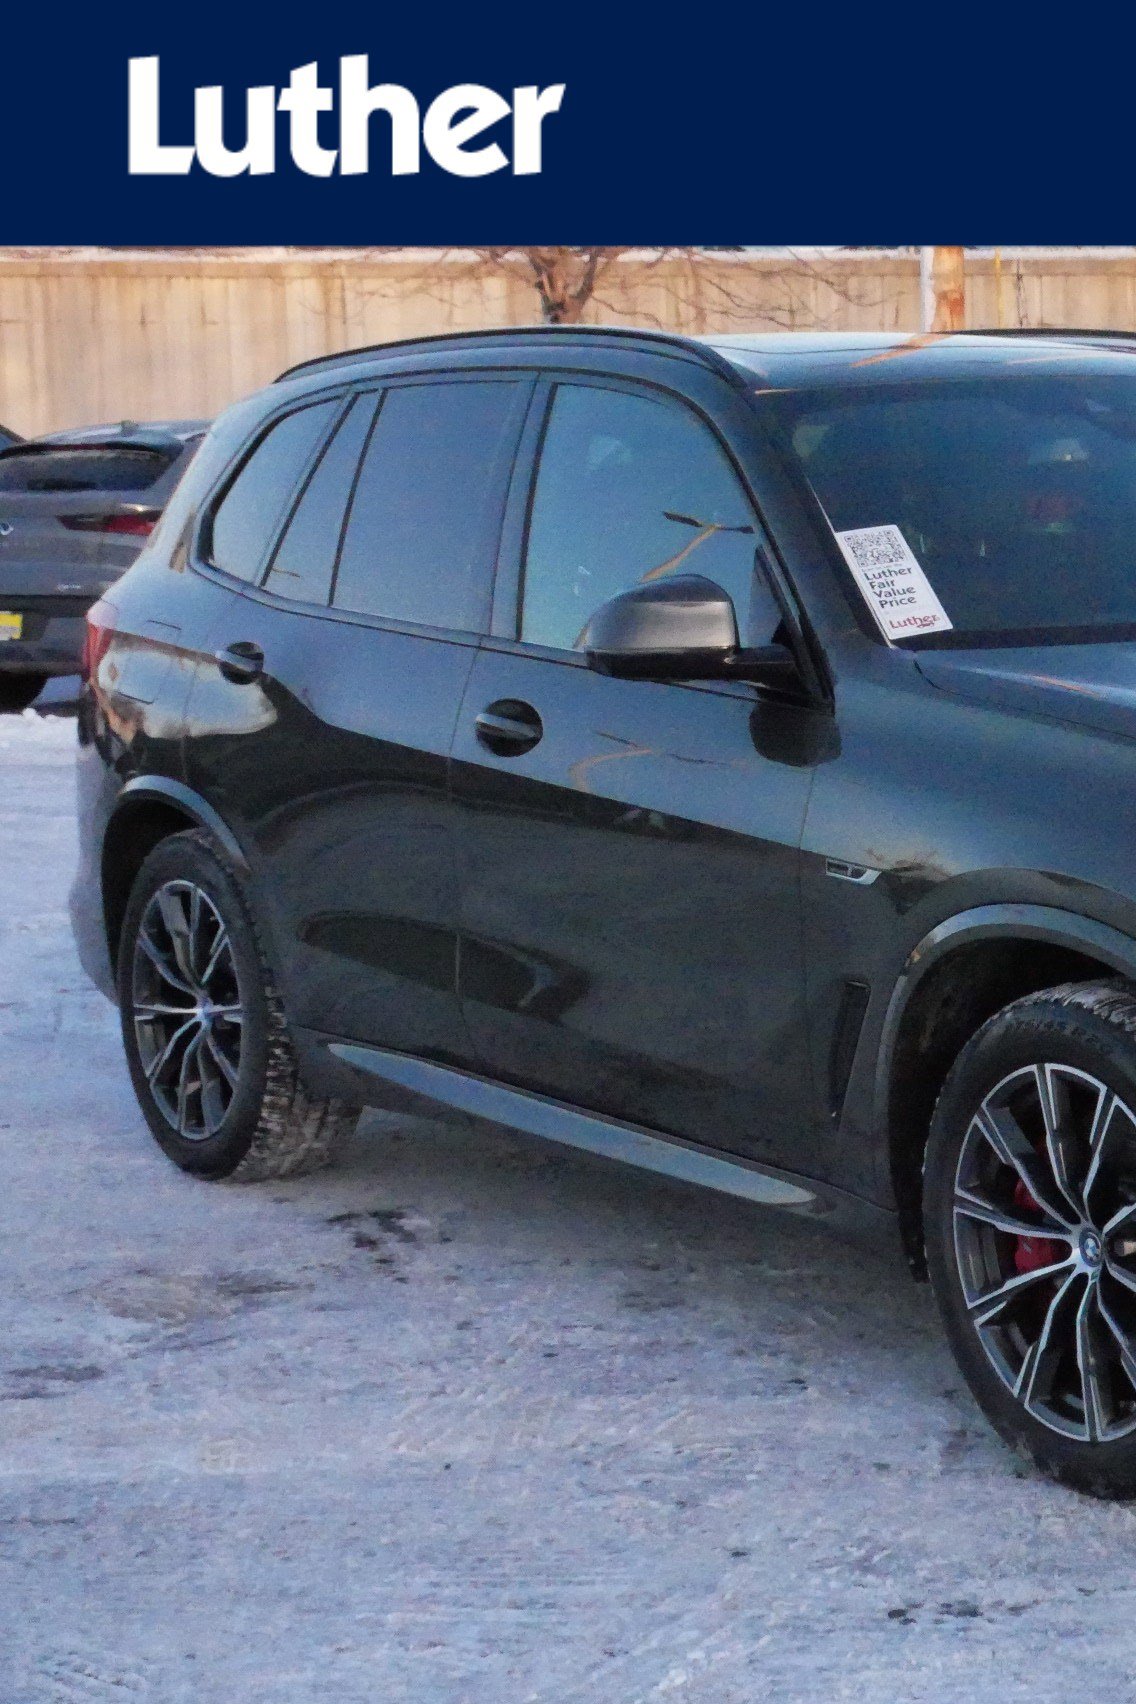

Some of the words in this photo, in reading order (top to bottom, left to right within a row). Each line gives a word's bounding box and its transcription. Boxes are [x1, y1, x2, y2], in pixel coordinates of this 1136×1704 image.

[863, 566, 912, 581] Luther
[869, 579, 895, 591] Fair
[873, 586, 916, 599] Value
[878, 596, 917, 609] Price
[888, 614, 938, 629] Luther
